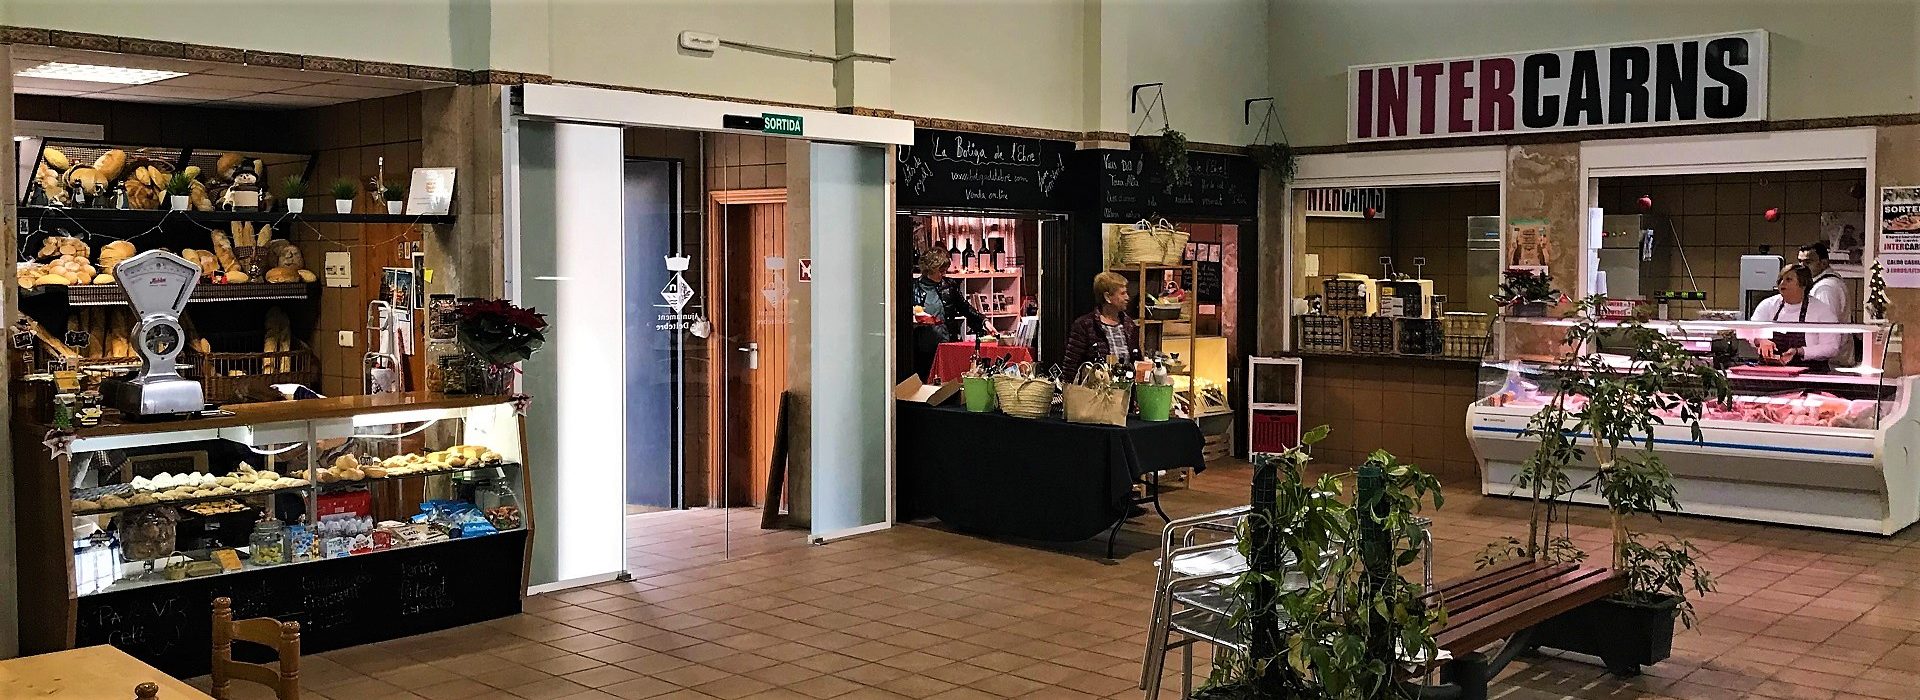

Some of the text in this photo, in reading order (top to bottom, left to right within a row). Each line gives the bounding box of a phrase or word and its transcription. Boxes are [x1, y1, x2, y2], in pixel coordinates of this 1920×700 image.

[1357, 37, 1749, 138] INTERCARNS
[764, 117, 801, 131] SORTIDA
[934, 137, 948, 157] La
[955, 136, 987, 164] Botiga
[994, 145, 1004, 160] de
